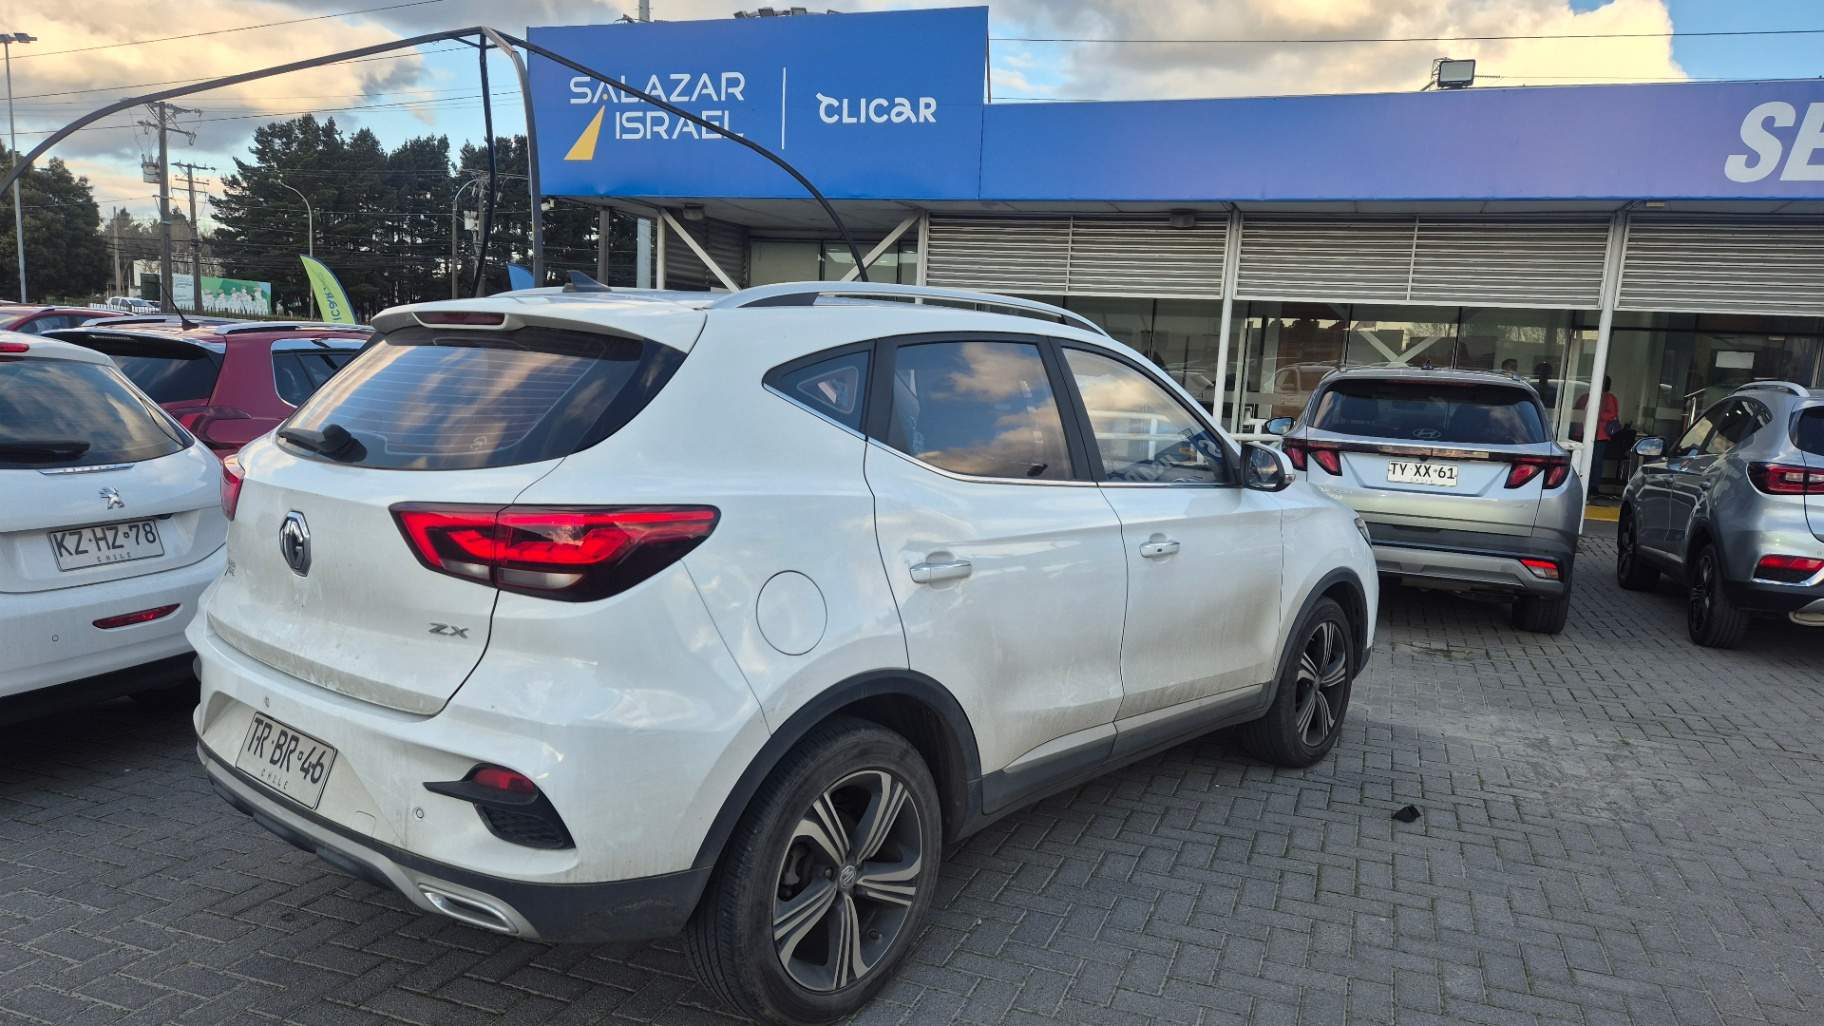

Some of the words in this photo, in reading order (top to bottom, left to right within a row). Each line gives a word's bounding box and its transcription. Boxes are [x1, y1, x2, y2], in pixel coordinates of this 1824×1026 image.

[569, 71, 746, 104] SALAZAR
[615, 110, 744, 139] ISRAEL
[428, 622, 470, 639] ZX
